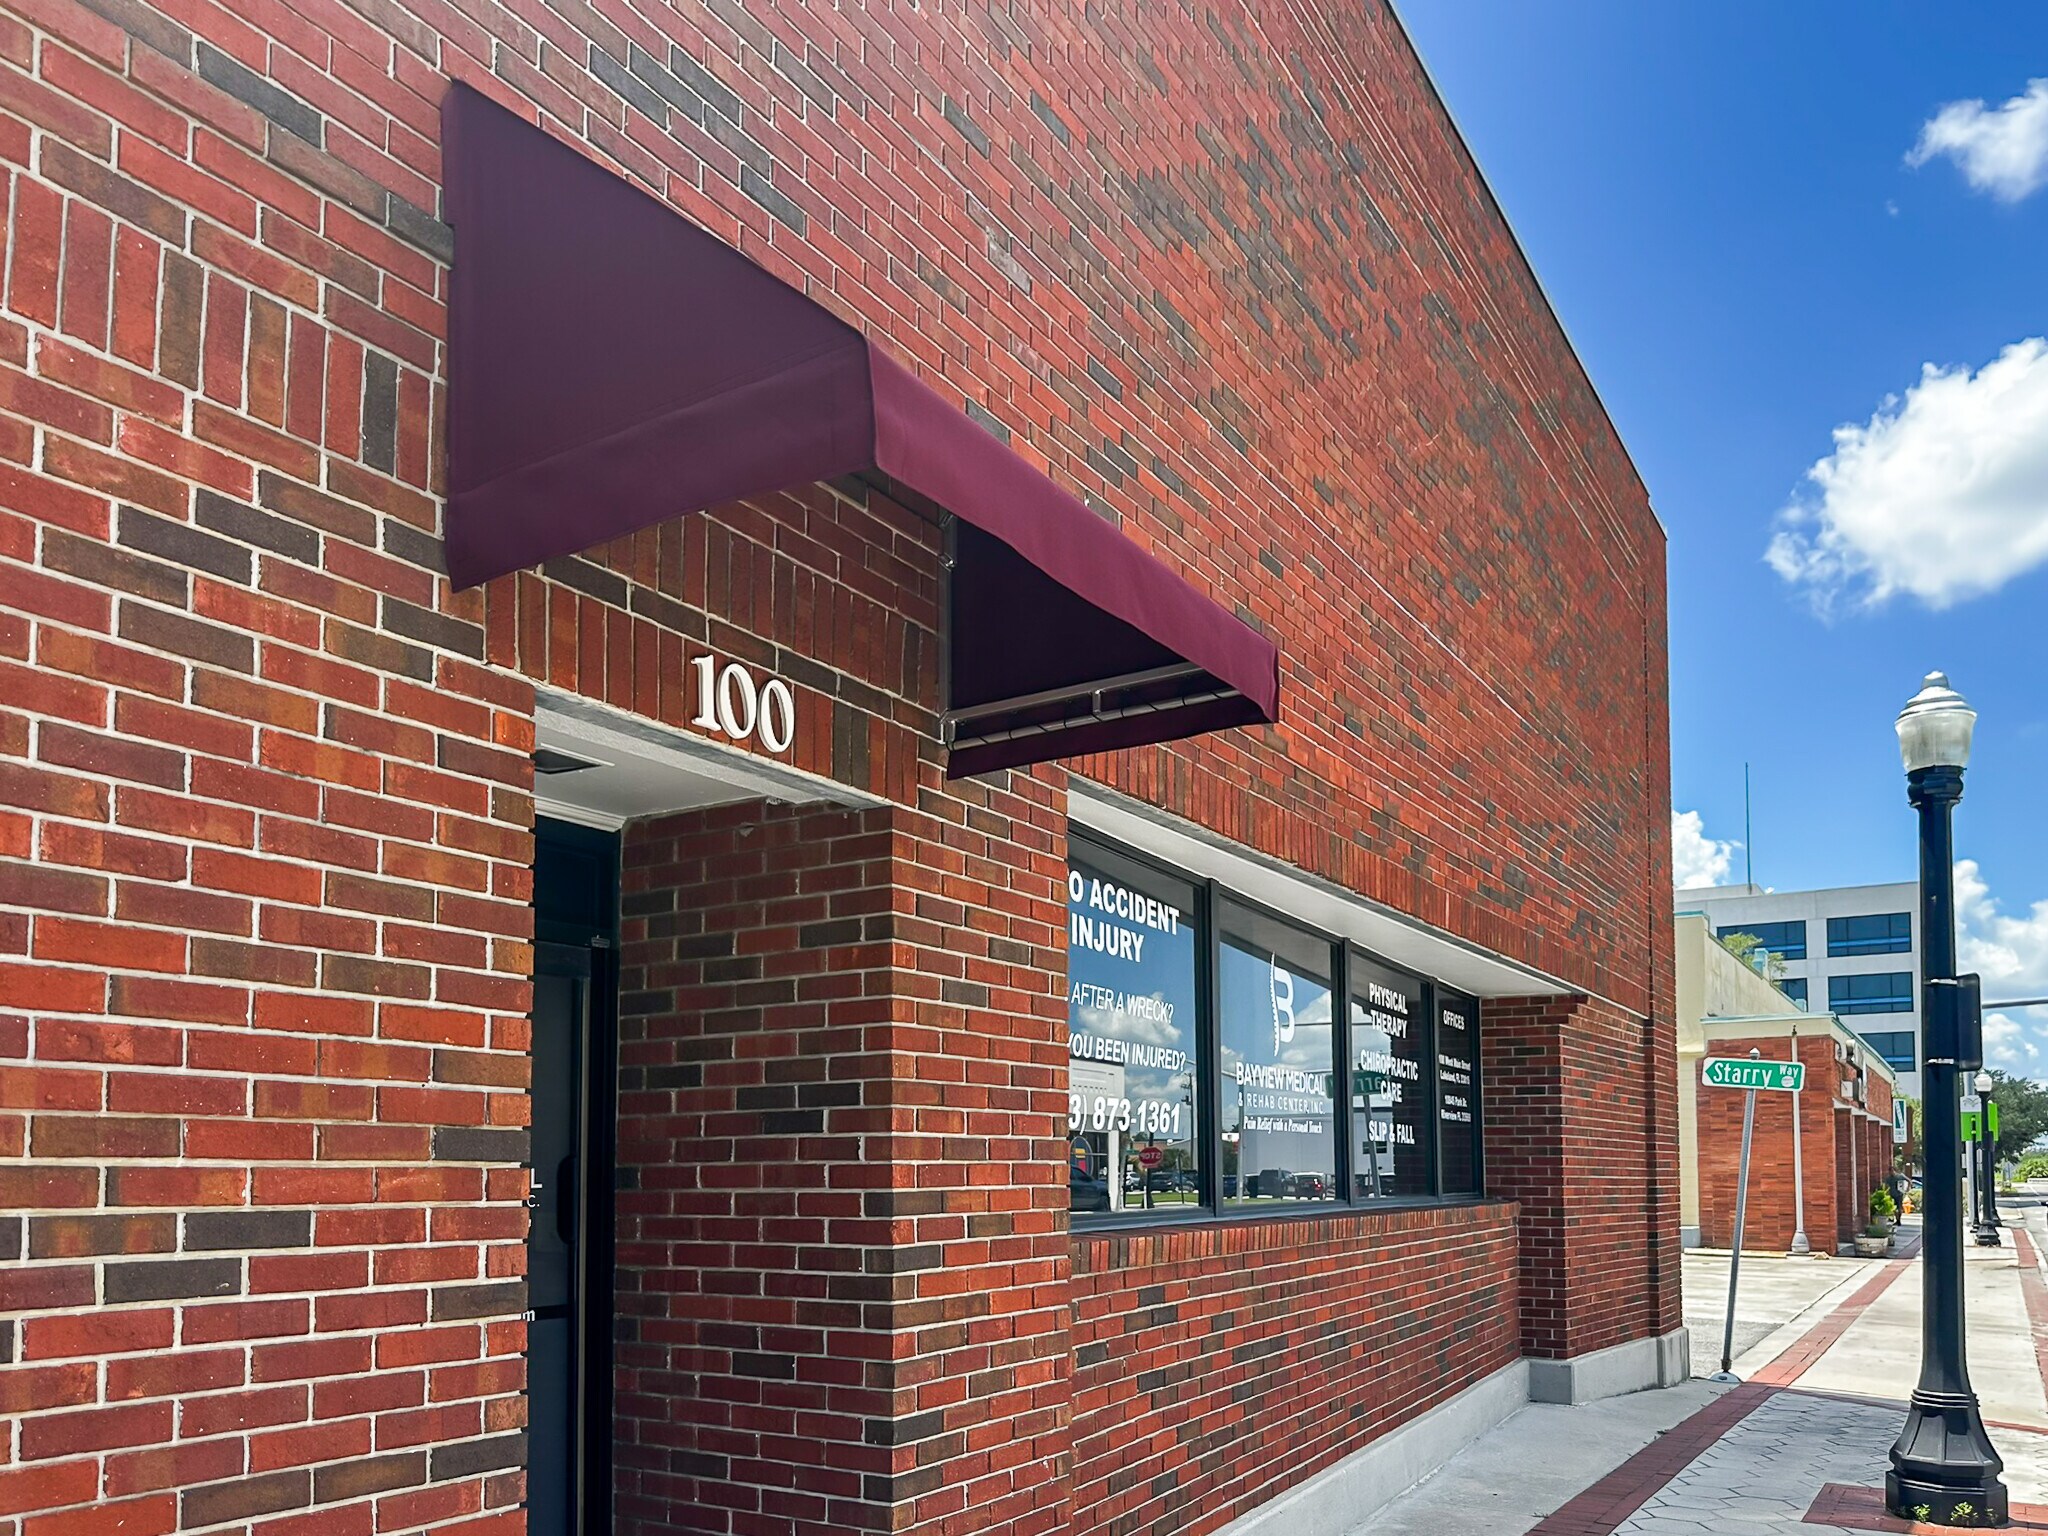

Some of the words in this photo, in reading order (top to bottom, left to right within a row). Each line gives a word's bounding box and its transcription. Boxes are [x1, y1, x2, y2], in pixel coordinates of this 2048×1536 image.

[690, 654, 795, 753] 100
[1067, 870, 1084, 903] O
[1089, 878, 1180, 936] ACCIDENT
[1071, 912, 1145, 963] INJURY
[1071, 981, 1115, 1012] AFTER
[1115, 992, 1125, 1014] A
[1127, 993, 1174, 1024] WRECK?
[1368, 982, 1409, 1015] PHYSICAL
[1370, 1009, 1407, 1039] THERAPY
[1095, 1037, 1130, 1064] BEEN
[1132, 1043, 1187, 1071] INJURED?
[1360, 1049, 1419, 1081] CHIROPRACTIC
[1235, 1061, 1285, 1090] BAYVIEW
[1284, 1069, 1326, 1096] MEDICAL
[1380, 1080, 1403, 1103] CARE
[1712, 1062, 1773, 1088] Starry
[1779, 1064, 1799, 1079] Way
[1092, 1096, 1180, 1134] 873-1361
[1238, 1091, 1243, 1107] &
[1246, 1093, 1275, 1110] REHAB
[1368, 1120, 1388, 1142] SLIP
[1388, 1122, 1396, 1143] &
[1396, 1123, 1416, 1145] FALL
